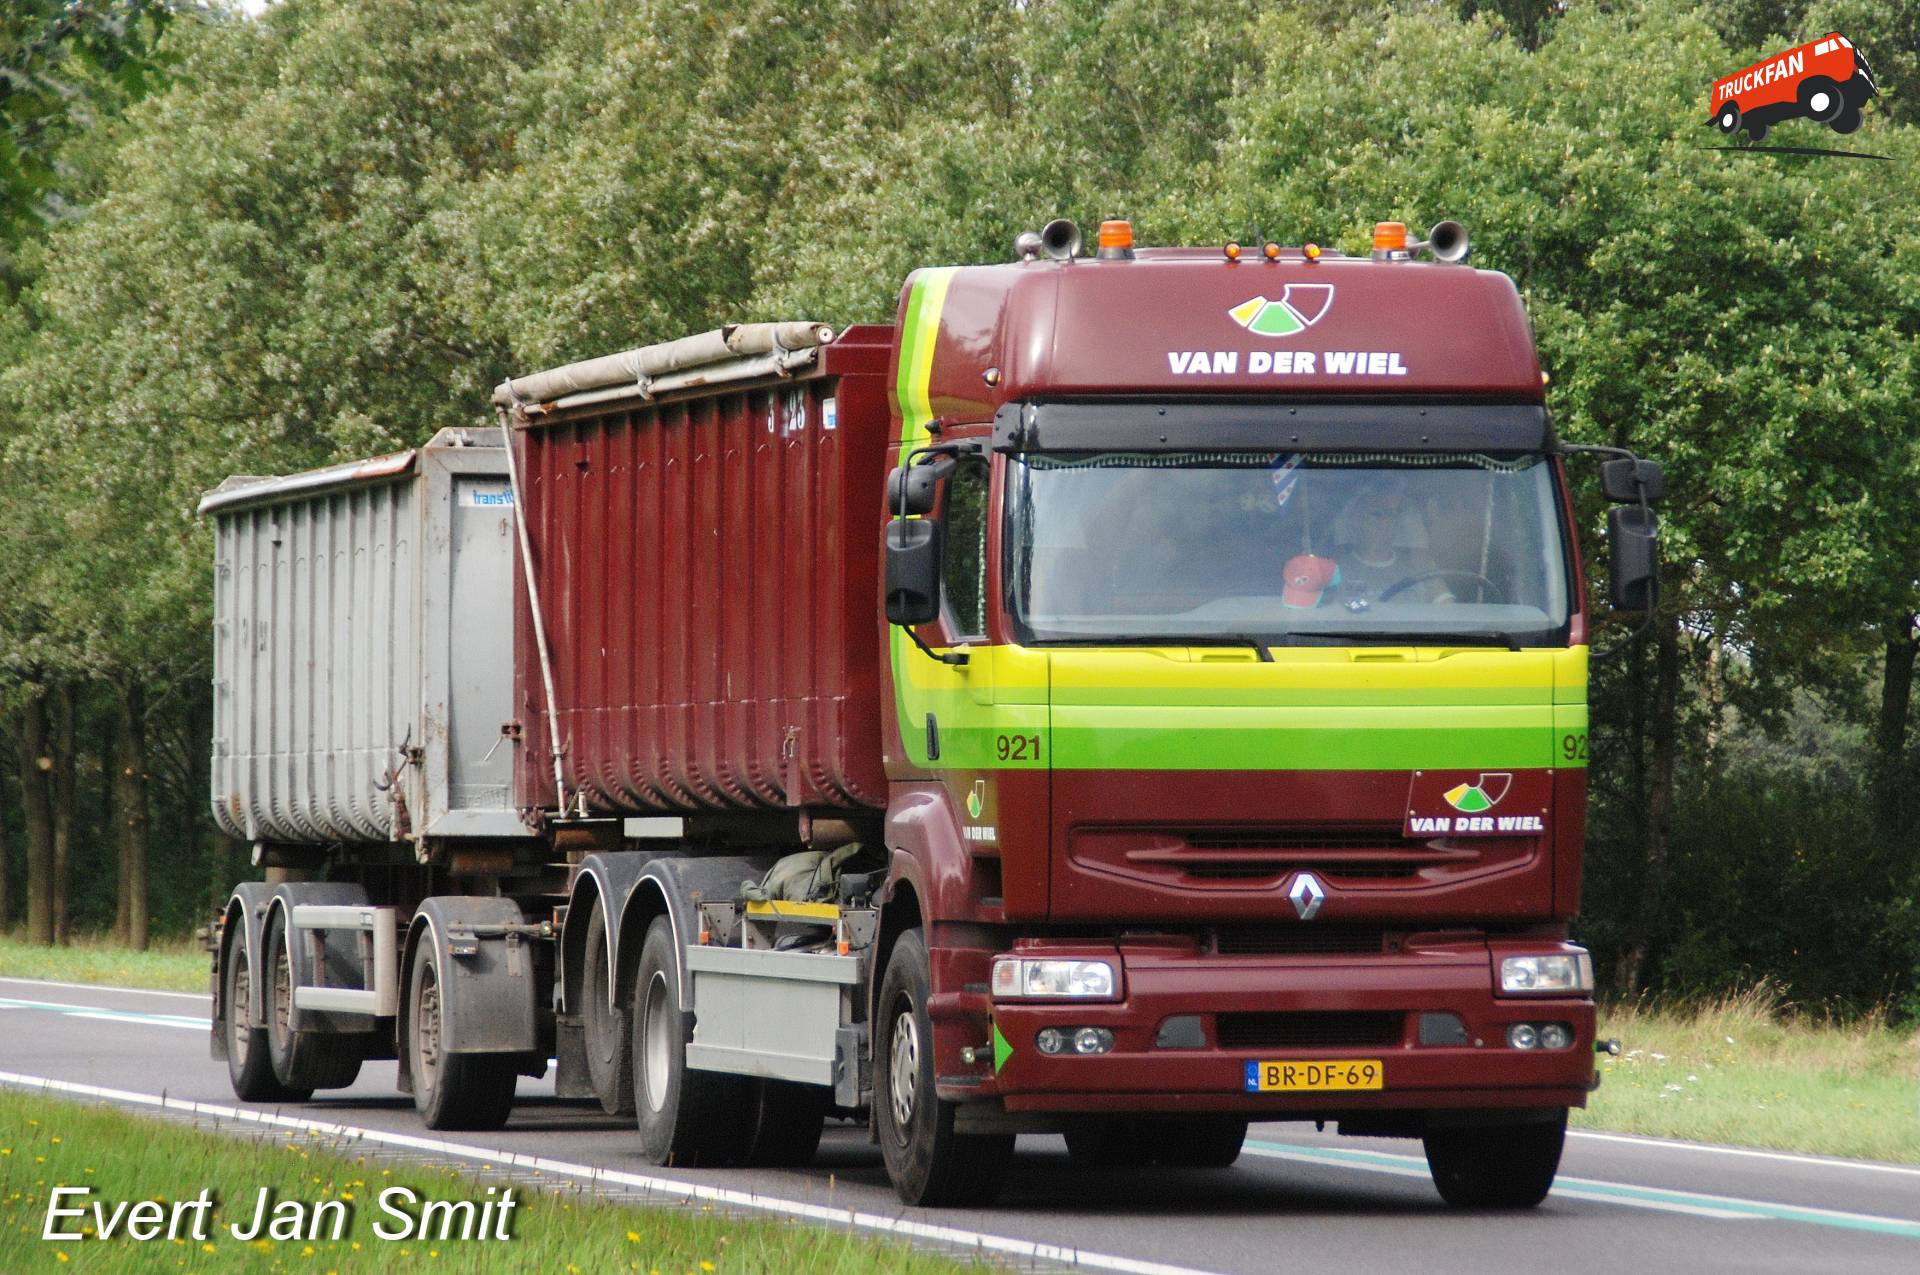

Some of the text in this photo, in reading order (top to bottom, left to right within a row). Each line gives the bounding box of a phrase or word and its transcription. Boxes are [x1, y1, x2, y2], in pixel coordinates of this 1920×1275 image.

[1168, 352, 1407, 375] VAN DER WIEL
[997, 735, 1040, 760] 921
[1410, 816, 1543, 831] VAN DER WIEL
[1247, 1064, 1376, 1086] NL BR-DF-69
